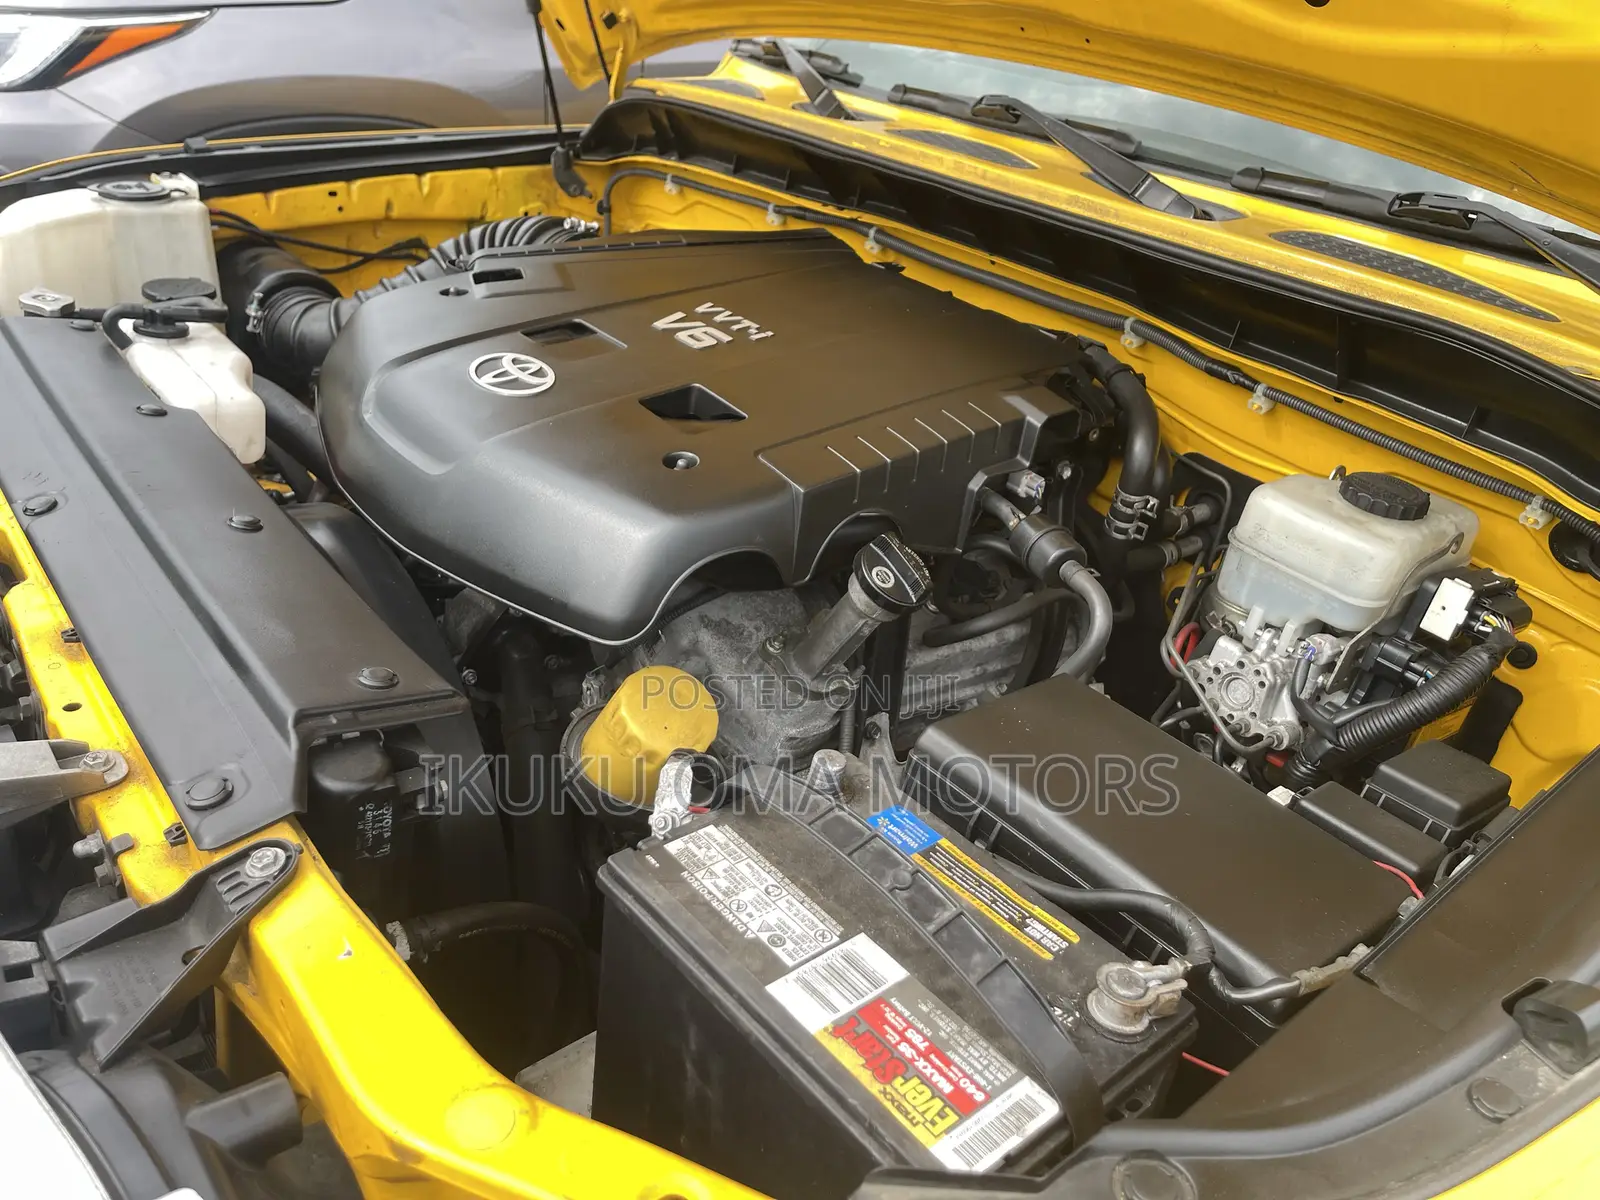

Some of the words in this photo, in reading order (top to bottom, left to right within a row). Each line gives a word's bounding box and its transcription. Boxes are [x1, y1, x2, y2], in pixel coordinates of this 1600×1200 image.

[652, 311, 734, 349] V6
[694, 302, 774, 340] VVT-i
[886, 823, 919, 848] Walmart
[680, 870, 746, 932] DANGER/POISON
[1023, 924, 1043, 939] NOT
[1025, 915, 1069, 948] STARTING?
[1039, 936, 1060, 951] CAR
[902, 1027, 932, 1051] 785
[831, 1016, 960, 1137] EverStart
[955, 1076, 987, 1102] 640
